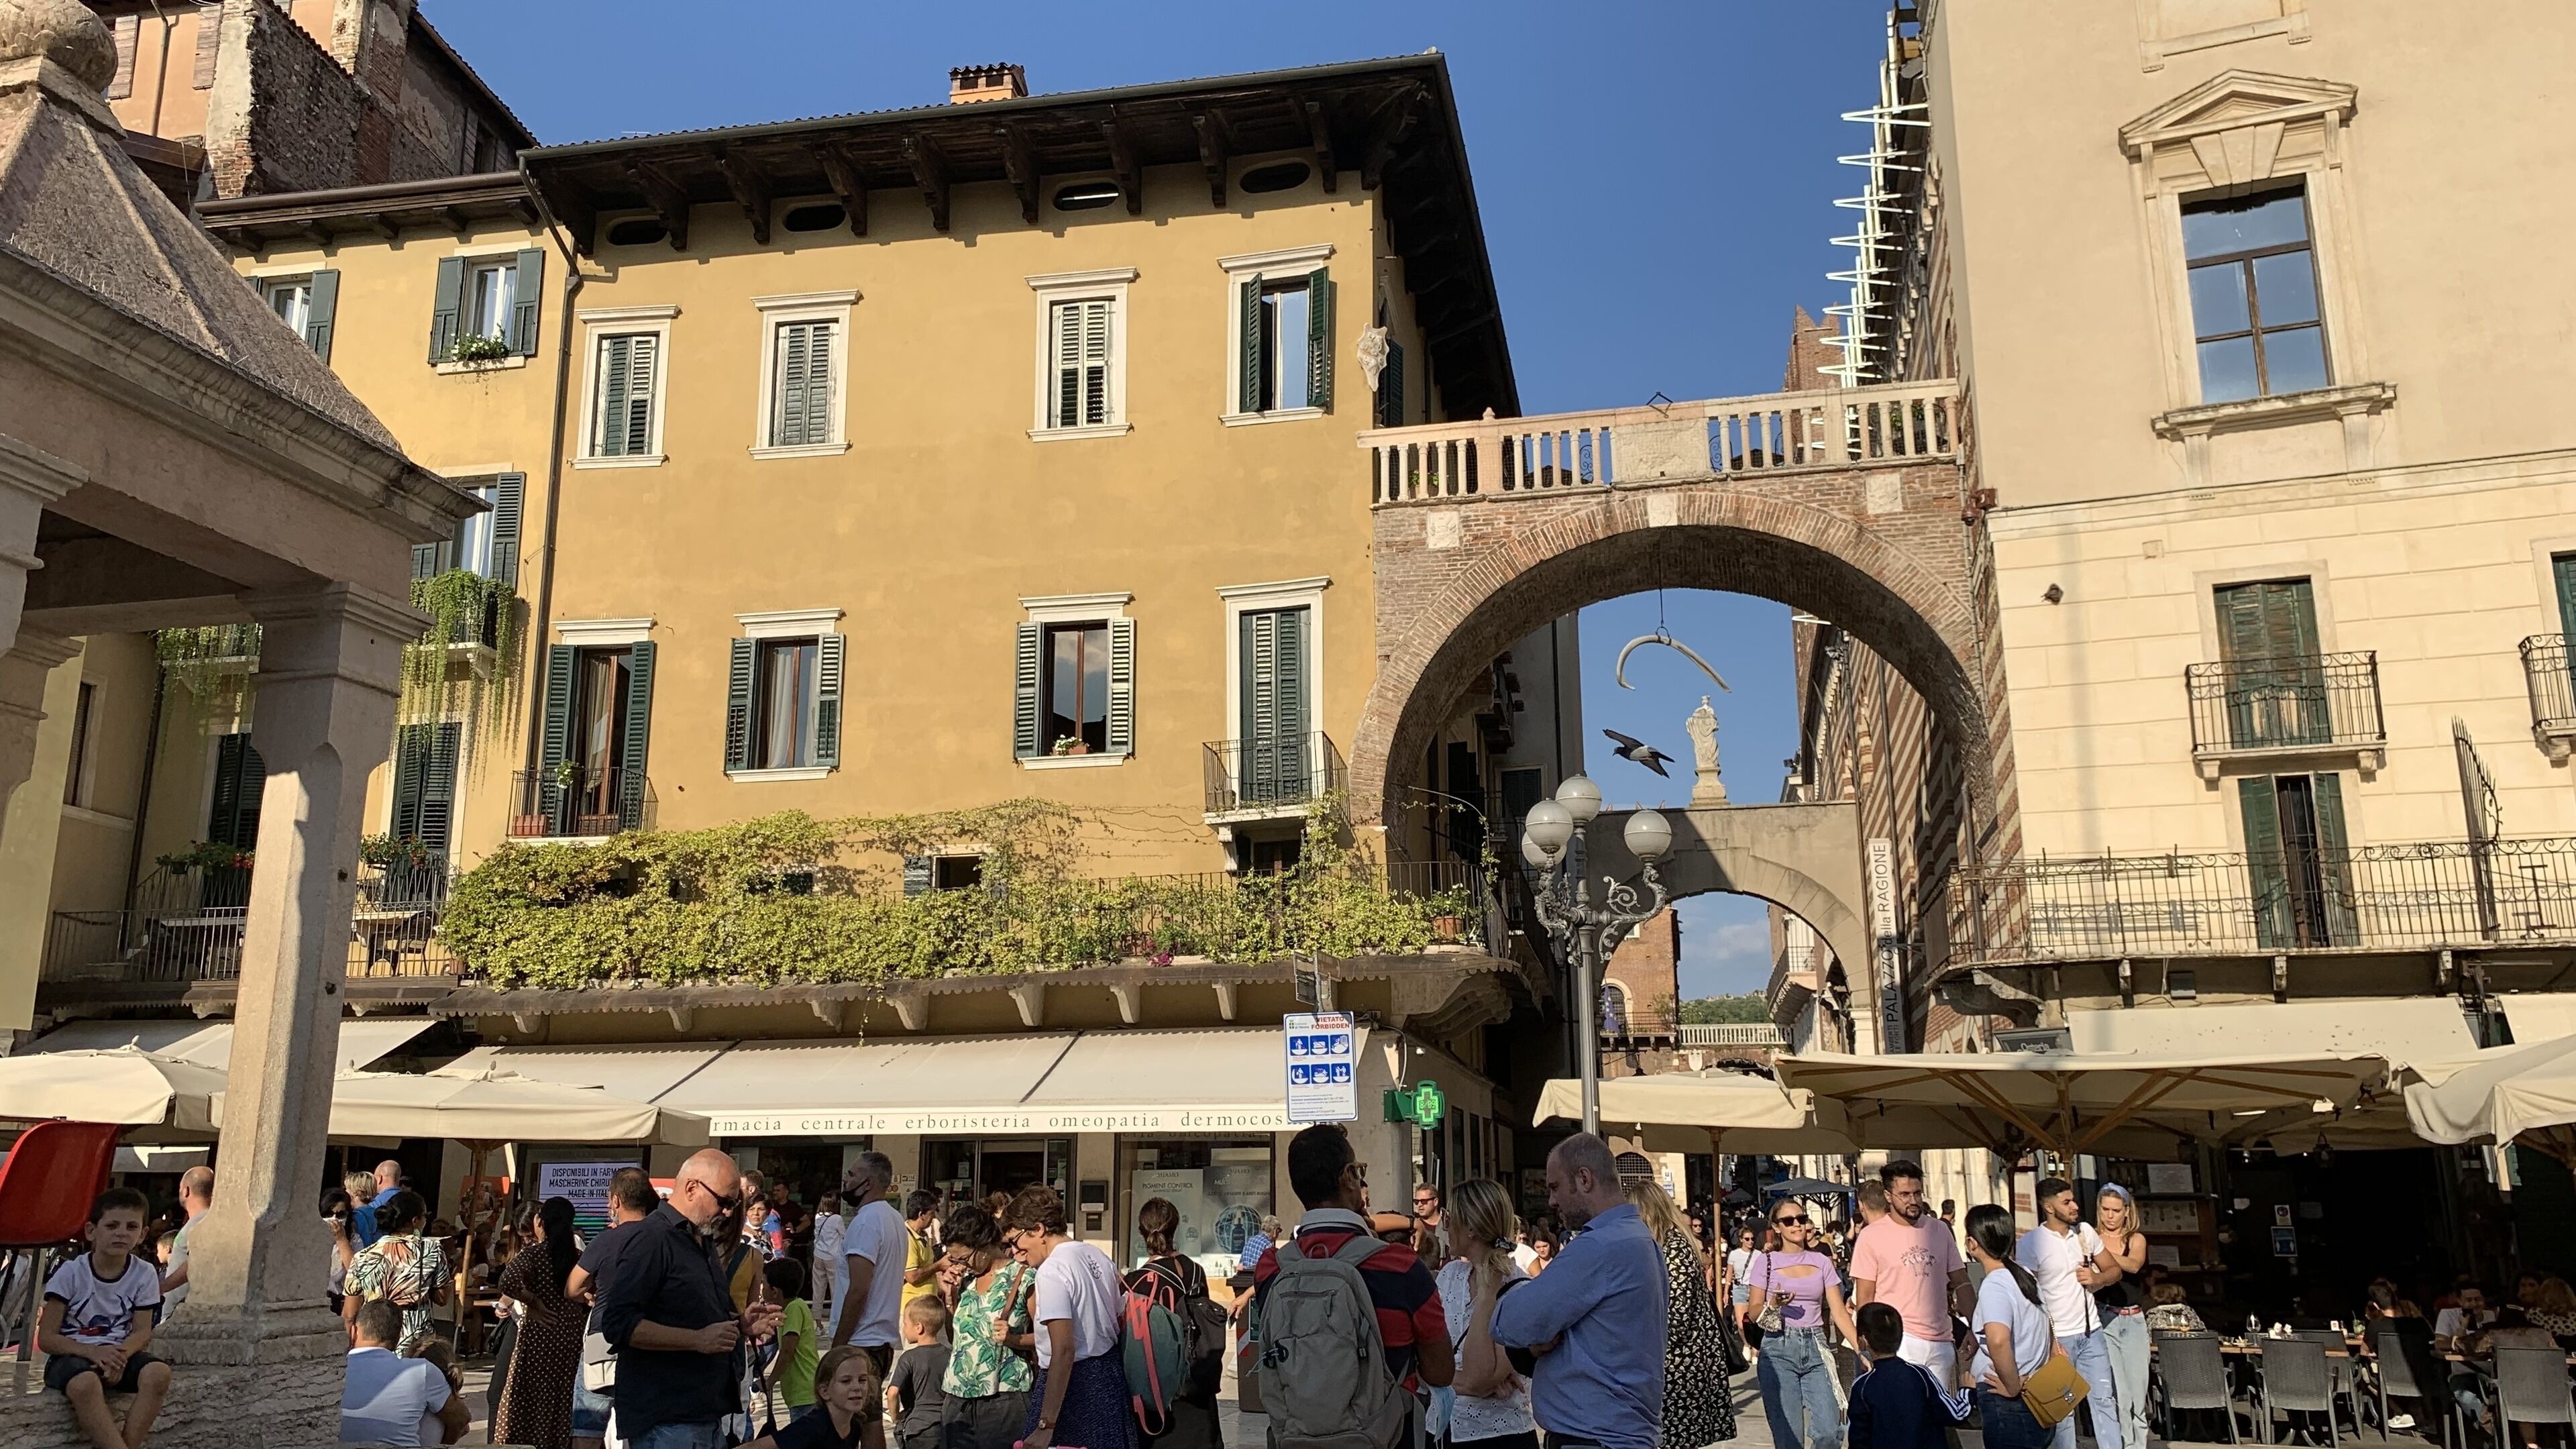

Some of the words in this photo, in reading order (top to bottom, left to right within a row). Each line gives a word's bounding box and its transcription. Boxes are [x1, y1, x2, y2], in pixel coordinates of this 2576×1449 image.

[1873, 845, 1890, 912] RAGIONE
[1880, 916, 1893, 945] della
[1881, 949, 1899, 1022] PALAZZO
[713, 1117, 781, 1132] rmacia
[801, 1115, 885, 1131] centrale
[906, 1114, 1030, 1129] erboristeria
[1049, 1112, 1160, 1130] omeopatia
[1181, 1111, 1313, 1127] dermocos
[549, 1178, 590, 1187] MASCHERINE
[590, 1178, 611, 1187] CHIRU
[552, 1167, 590, 1177] DISPONIBILI
[591, 1167, 598, 1177] IN
[599, 1167, 620, 1177] FARM
[568, 1189, 586, 1197] MADE
[588, 1189, 595, 1197] IN
[596, 1189, 609, 1197] ITAL
